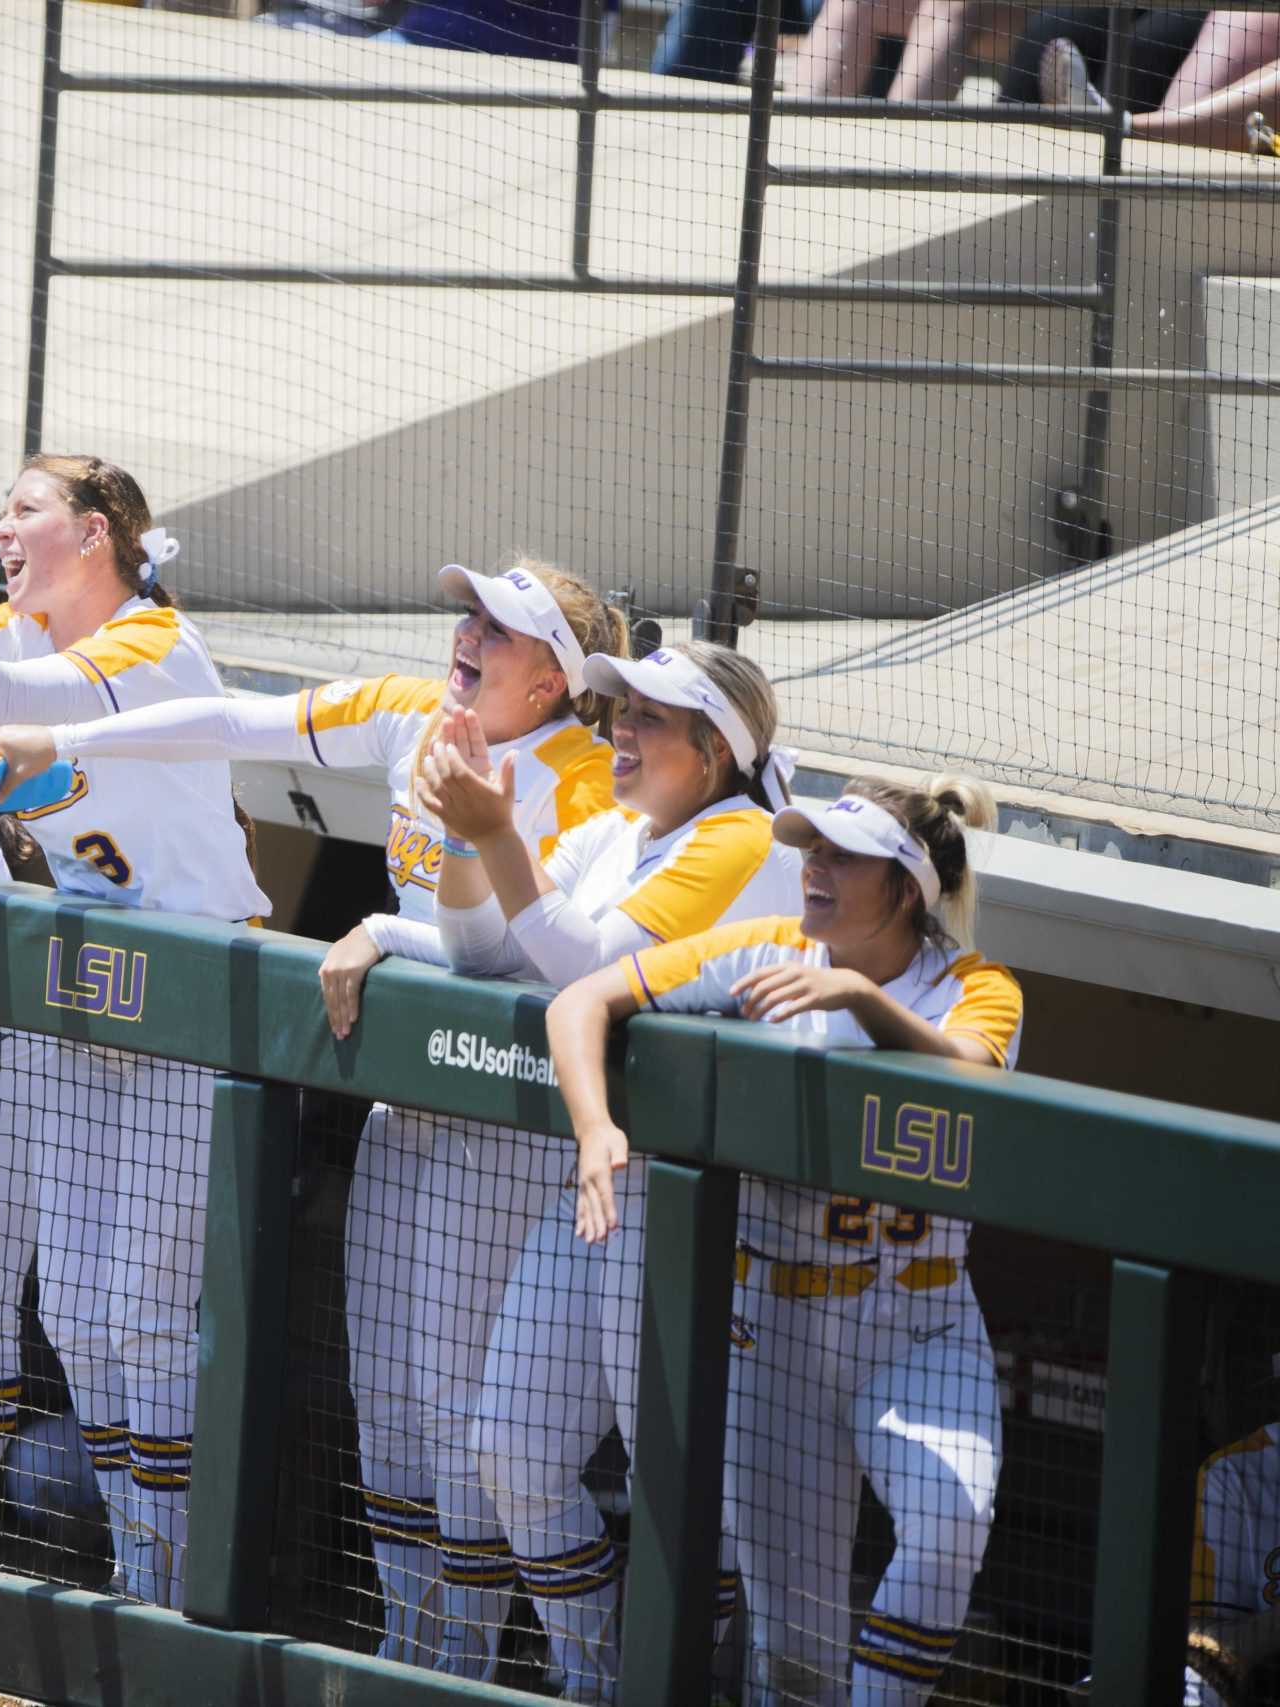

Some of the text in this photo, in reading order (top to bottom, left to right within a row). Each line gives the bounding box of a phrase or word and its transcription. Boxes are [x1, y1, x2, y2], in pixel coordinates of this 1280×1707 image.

[72, 830, 133, 887] 3
[44, 935, 148, 1022] LSU
[860, 1093, 974, 1190] LSU
